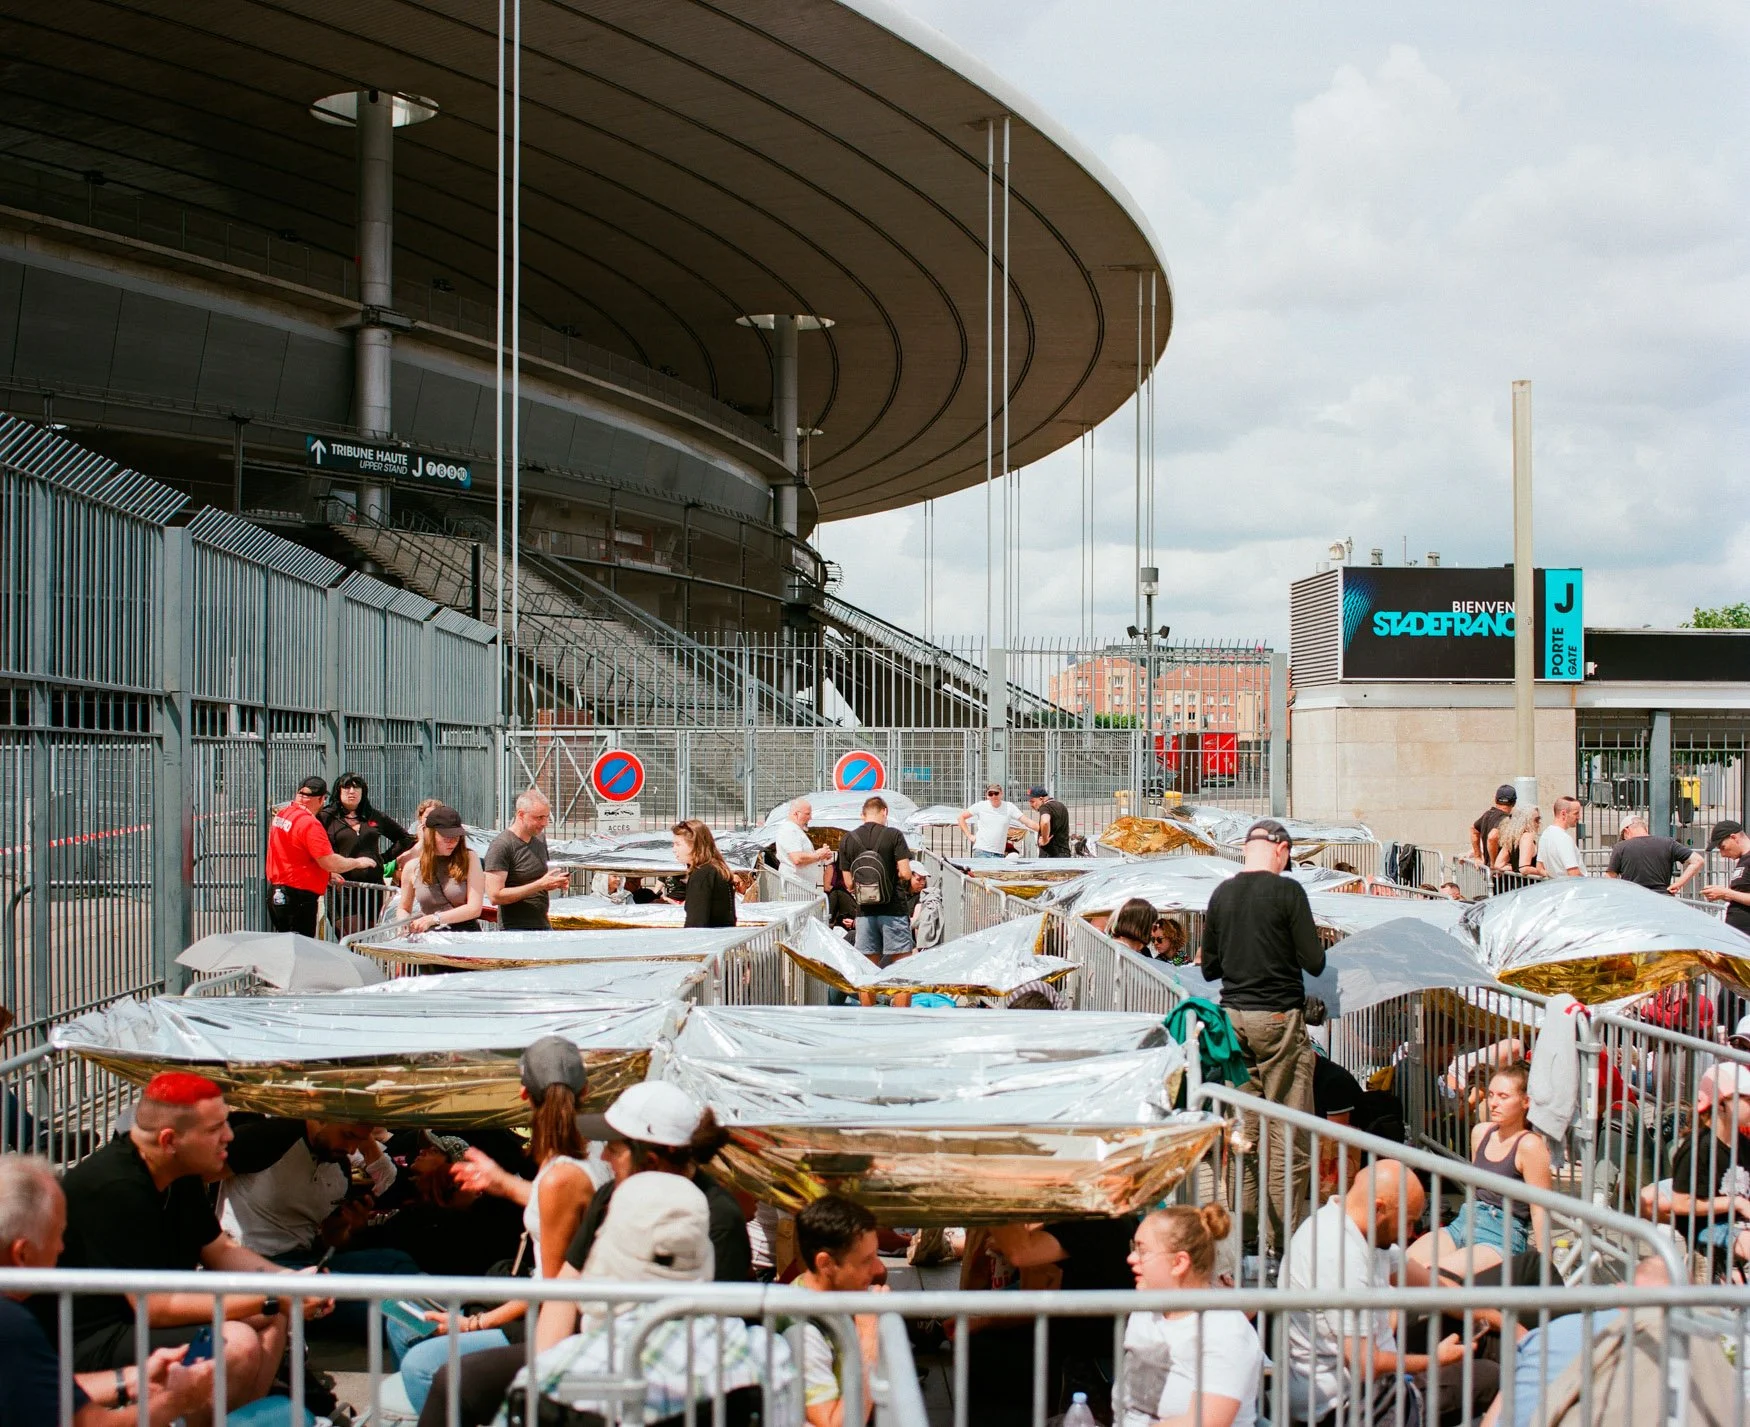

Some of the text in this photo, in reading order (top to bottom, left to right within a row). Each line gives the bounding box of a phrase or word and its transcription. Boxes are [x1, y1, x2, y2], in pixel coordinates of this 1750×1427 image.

[331, 443, 408, 465] TRIBUNE HAUTE
[360, 460, 408, 475] UPPER STAND
[412, 456, 422, 477] J
[1452, 601, 1515, 613] BIENVEN
[1554, 583, 1574, 613] J
[1373, 611, 1515, 637] STADEFRANC
[1552, 628, 1564, 675] PORTE
[1568, 645, 1577, 675] GATE
